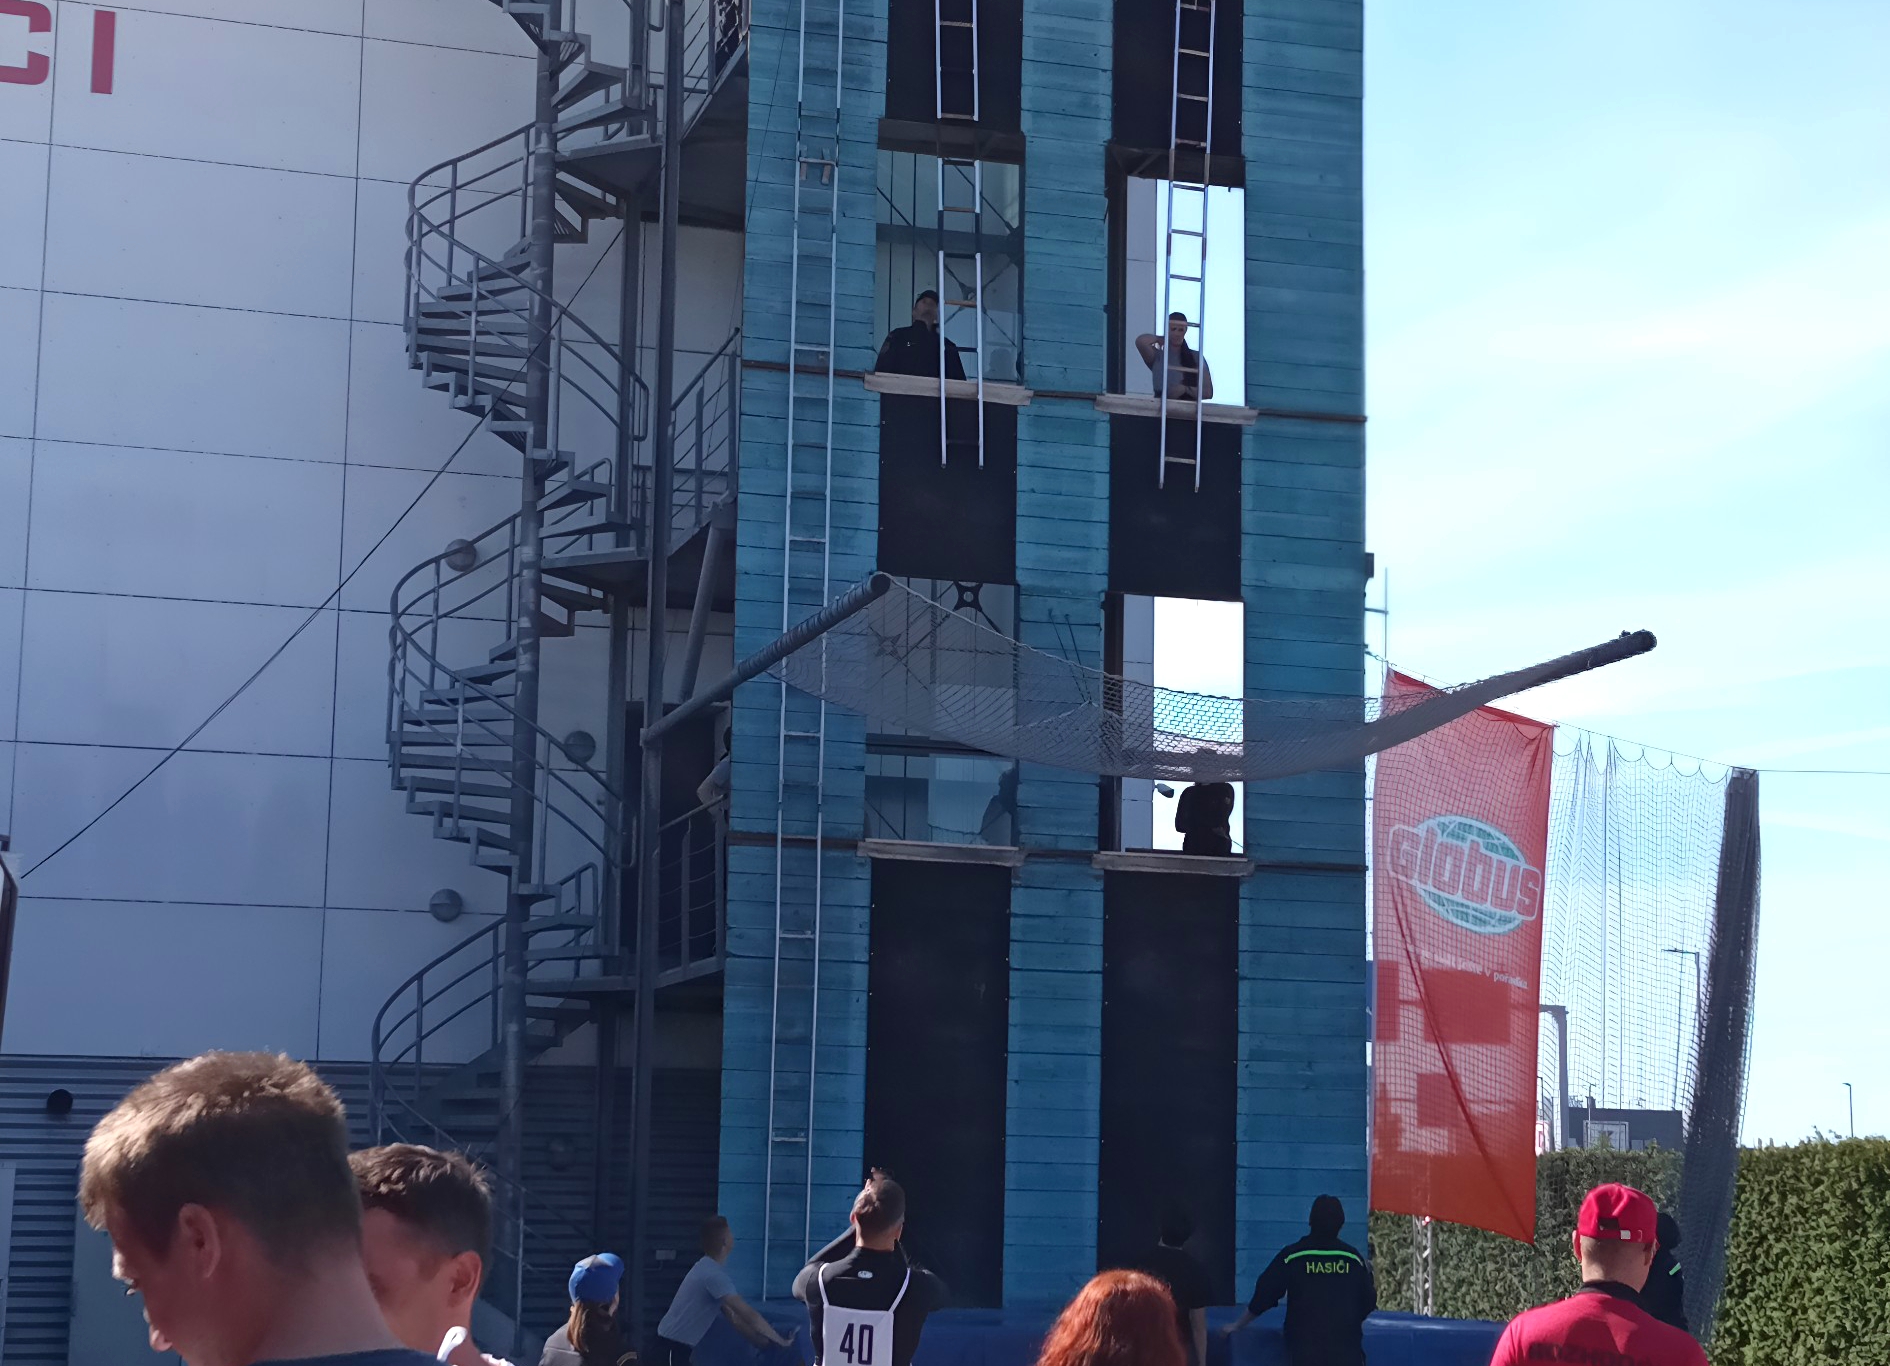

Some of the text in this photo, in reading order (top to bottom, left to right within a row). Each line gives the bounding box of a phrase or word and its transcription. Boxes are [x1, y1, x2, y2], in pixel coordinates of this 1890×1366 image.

[1388, 824, 1542, 921] Globus
[1306, 1260, 1350, 1274] HASIČI
[839, 1322, 874, 1365] 40
